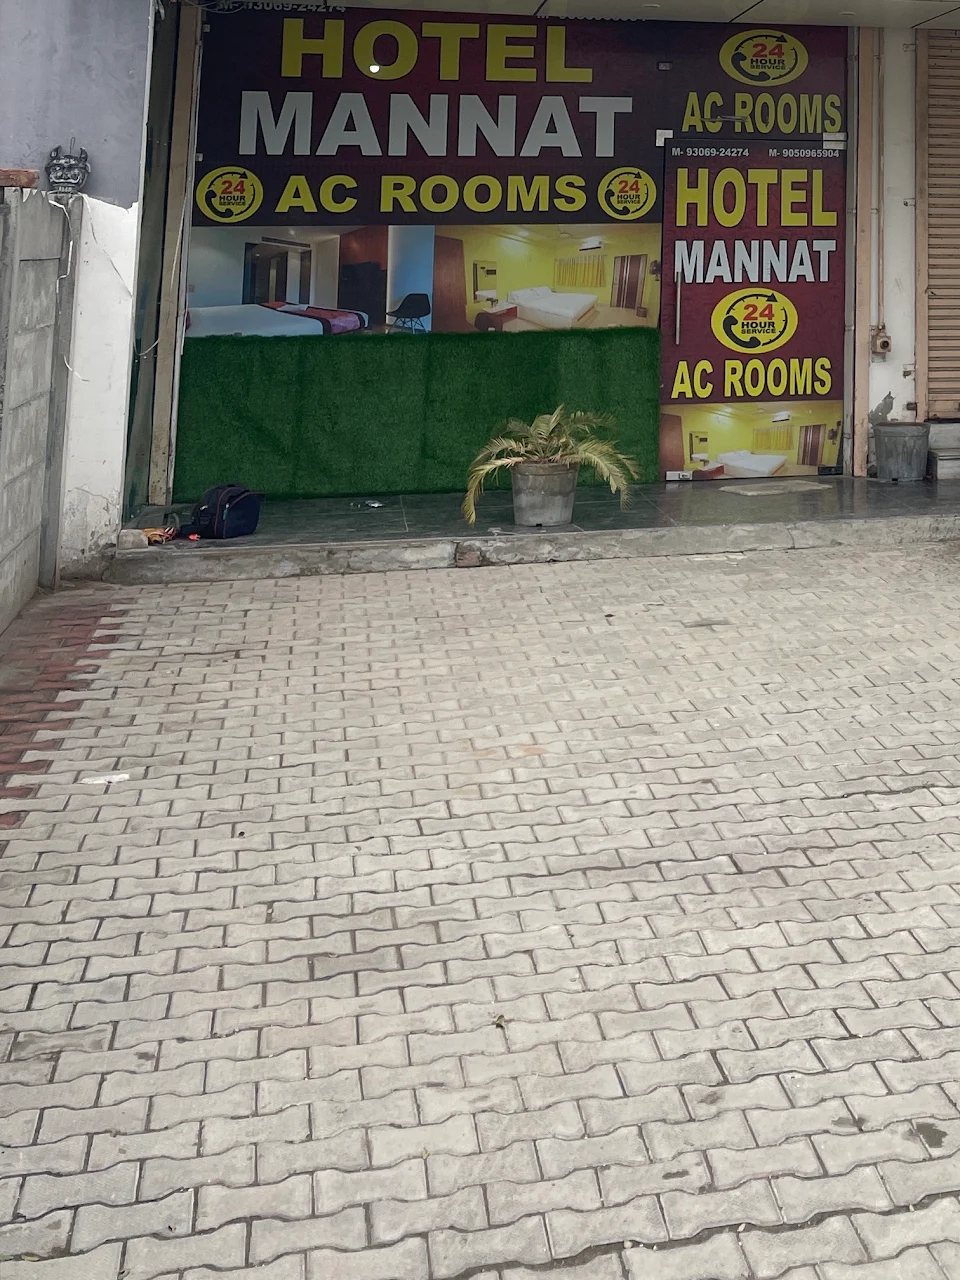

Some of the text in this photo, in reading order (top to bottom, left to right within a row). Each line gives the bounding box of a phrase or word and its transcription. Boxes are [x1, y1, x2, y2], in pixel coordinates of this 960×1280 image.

[281, 17, 593, 83] HOTEL
[752, 43, 785, 58] 24
[238, 91, 633, 158] MANNAT
[682, 91, 842, 134] AC ROOMS
[671, 147, 840, 158] M- 93069-24274 M- 9050965904
[220, 180, 246, 195] 24
[274, 175, 587, 213] AC ROOMS
[618, 180, 640, 194] 24
[675, 168, 838, 228] HOTEL
[674, 239, 837, 284] MANNAT
[741, 321, 776, 329] HOUR
[743, 303, 775, 321] 24
[671, 357, 832, 399] AC ROOMS
